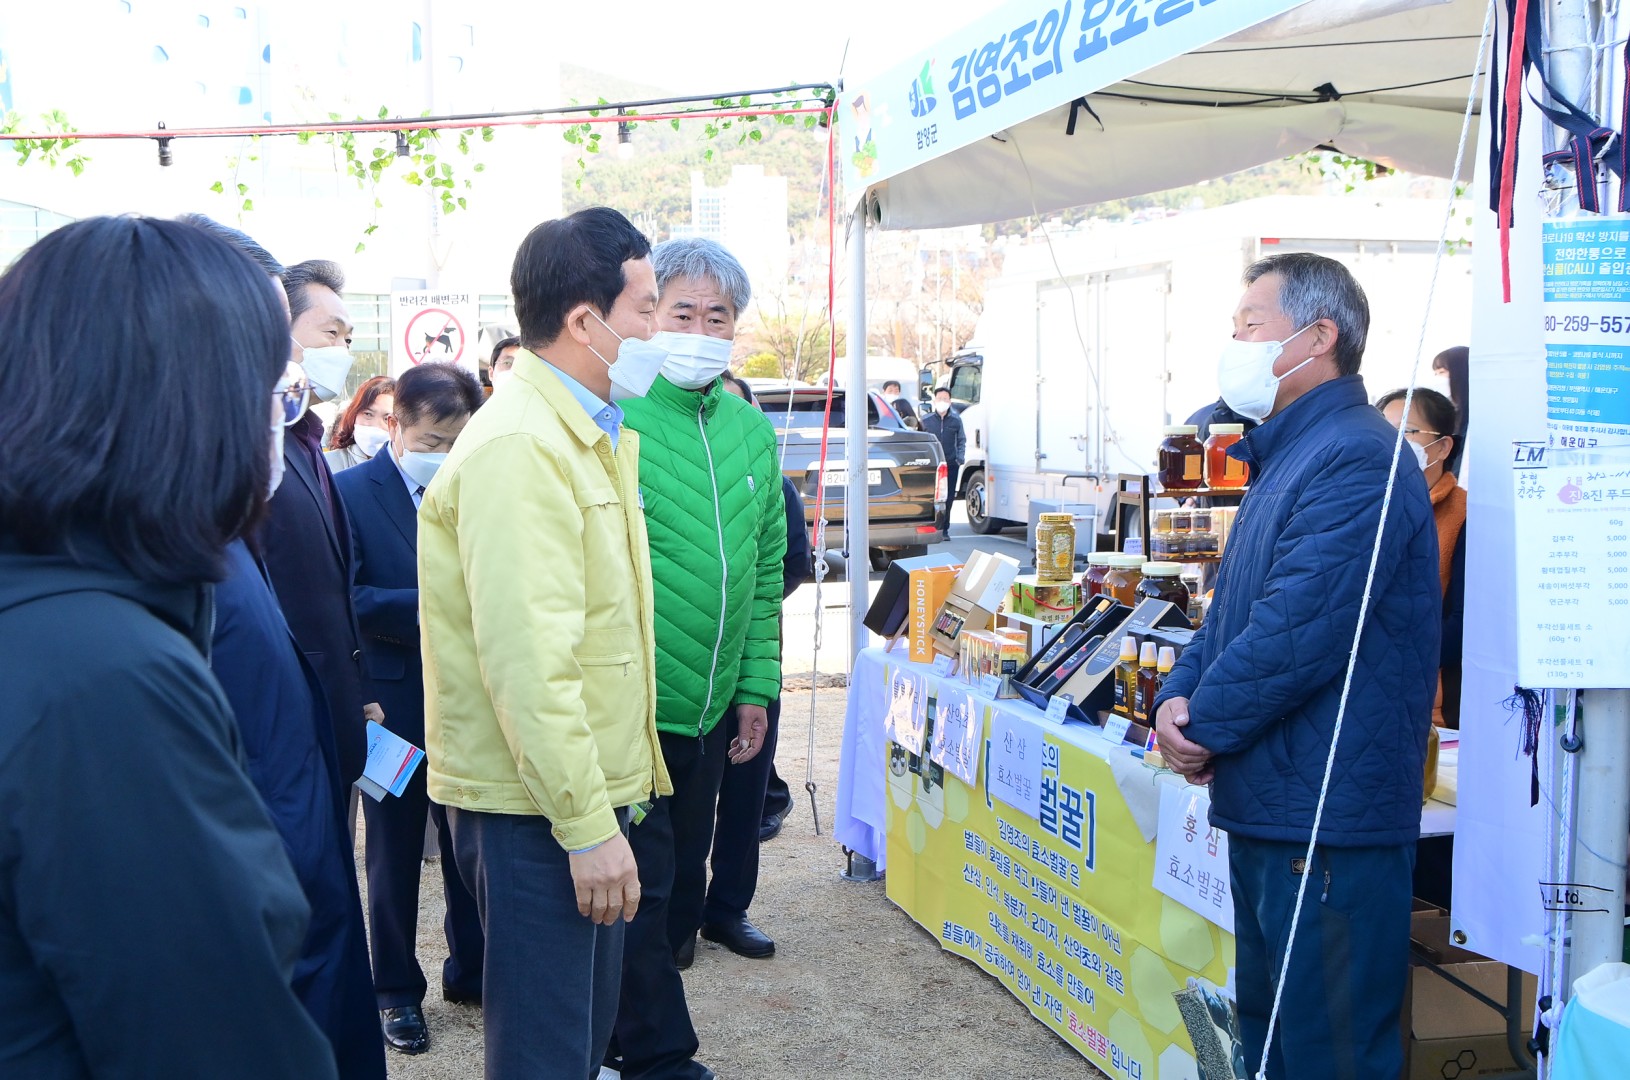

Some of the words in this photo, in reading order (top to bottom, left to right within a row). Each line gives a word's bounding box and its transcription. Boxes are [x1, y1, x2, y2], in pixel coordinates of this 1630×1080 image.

[948, 0, 1072, 121] 김영조의
[916, 123, 938, 150] 함양군
[1576, 231, 1596, 243] 확산
[1598, 230, 1630, 243] 방지를
[399, 295, 428, 307] 반려견
[431, 294, 469, 305] 배변금지
[1561, 436, 1598, 448] 해운대구
[1609, 519, 1623, 527] 60g
[916, 579, 926, 656] HONEYSTICK
[996, 764, 1033, 801] 효소벌꿀
[964, 829, 988, 861] 벌들이
[1013, 862, 1029, 889] 먹고
[1060, 893, 1070, 918] 낸
[1072, 902, 1100, 940] 벌꿀이
[1101, 922, 1122, 955] 아닌
[1166, 854, 1227, 909] 효소벌꿀
[1556, 888, 1583, 906] Ltd.
[942, 920, 983, 957] 벌들에게
[1032, 985, 1042, 1008] 낸
[1043, 992, 1063, 1025] 자연
[1036, 951, 1064, 990] 효소를
[1067, 971, 1095, 1012] 만들어
[1063, 934, 1102, 978] 산약초와
[1104, 961, 1125, 996] 같은
